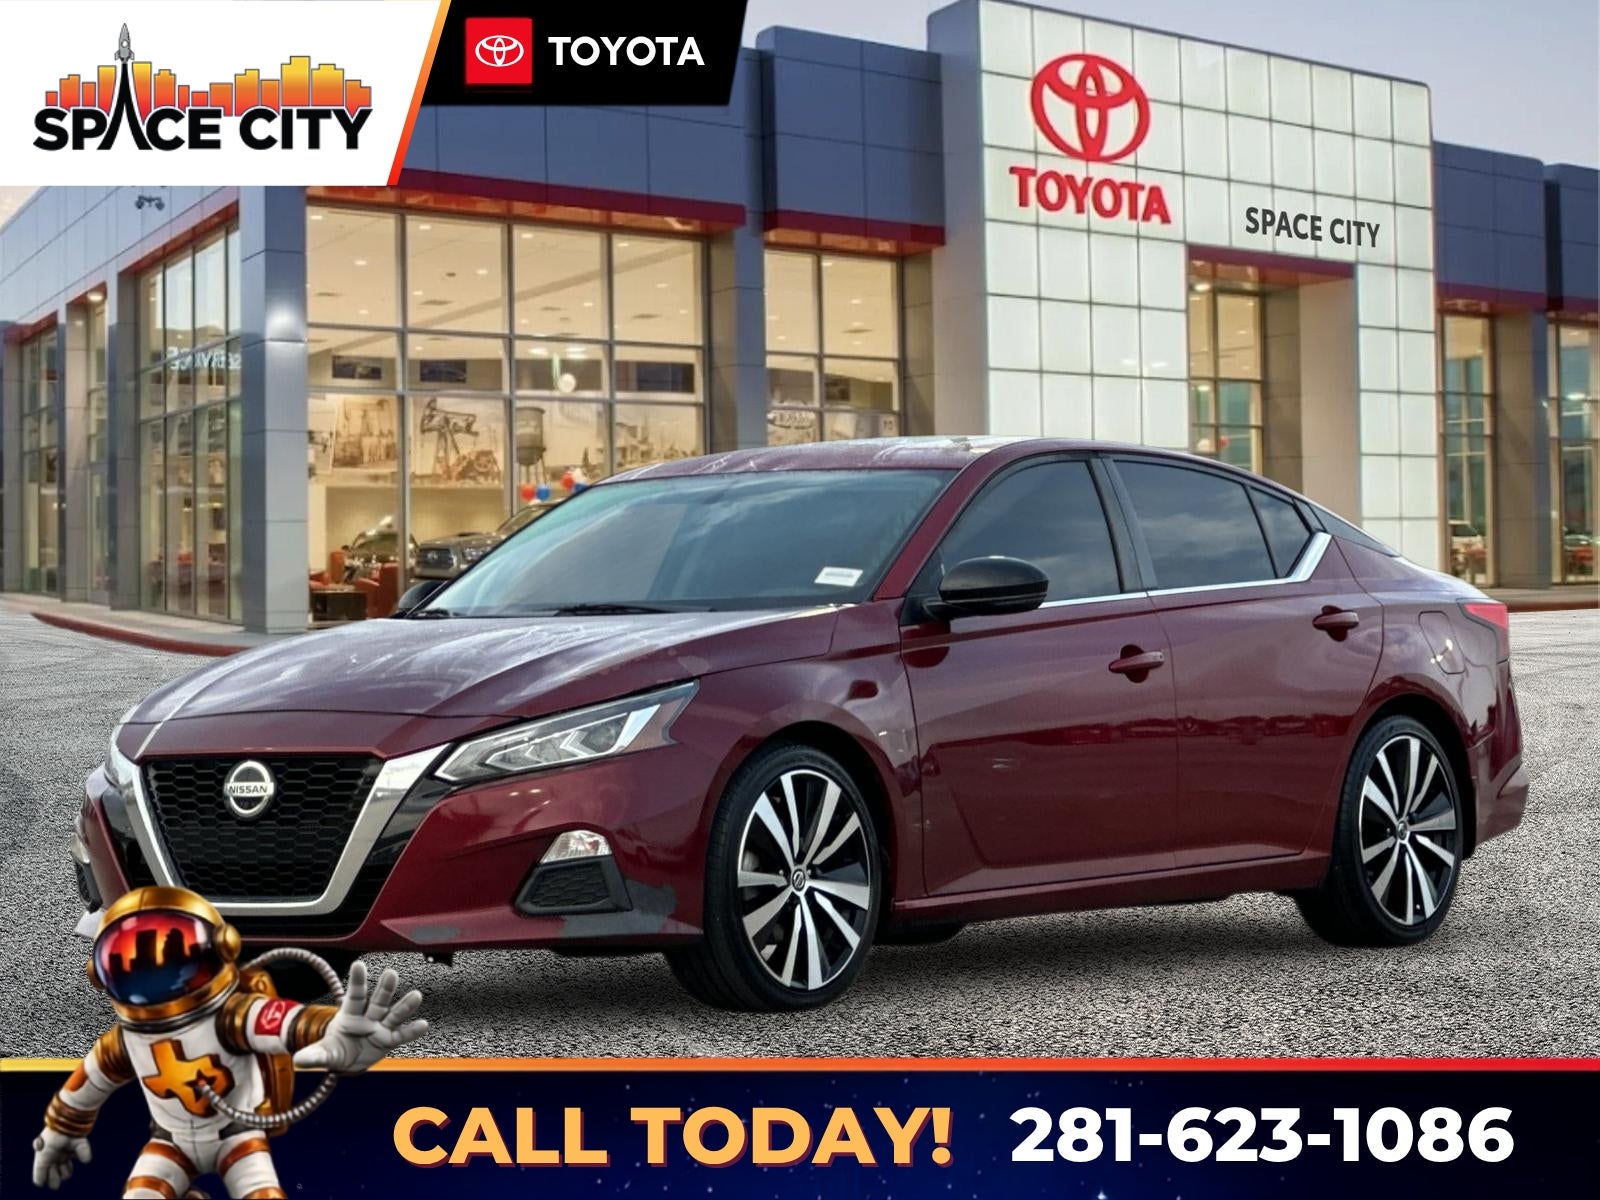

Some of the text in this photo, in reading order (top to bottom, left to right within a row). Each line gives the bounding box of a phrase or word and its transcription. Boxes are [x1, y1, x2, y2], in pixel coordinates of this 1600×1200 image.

[1008, 166, 1171, 225] TOYOTA
[1245, 206, 1381, 248] SPACE CITY
[229, 785, 268, 795] NISSAN
